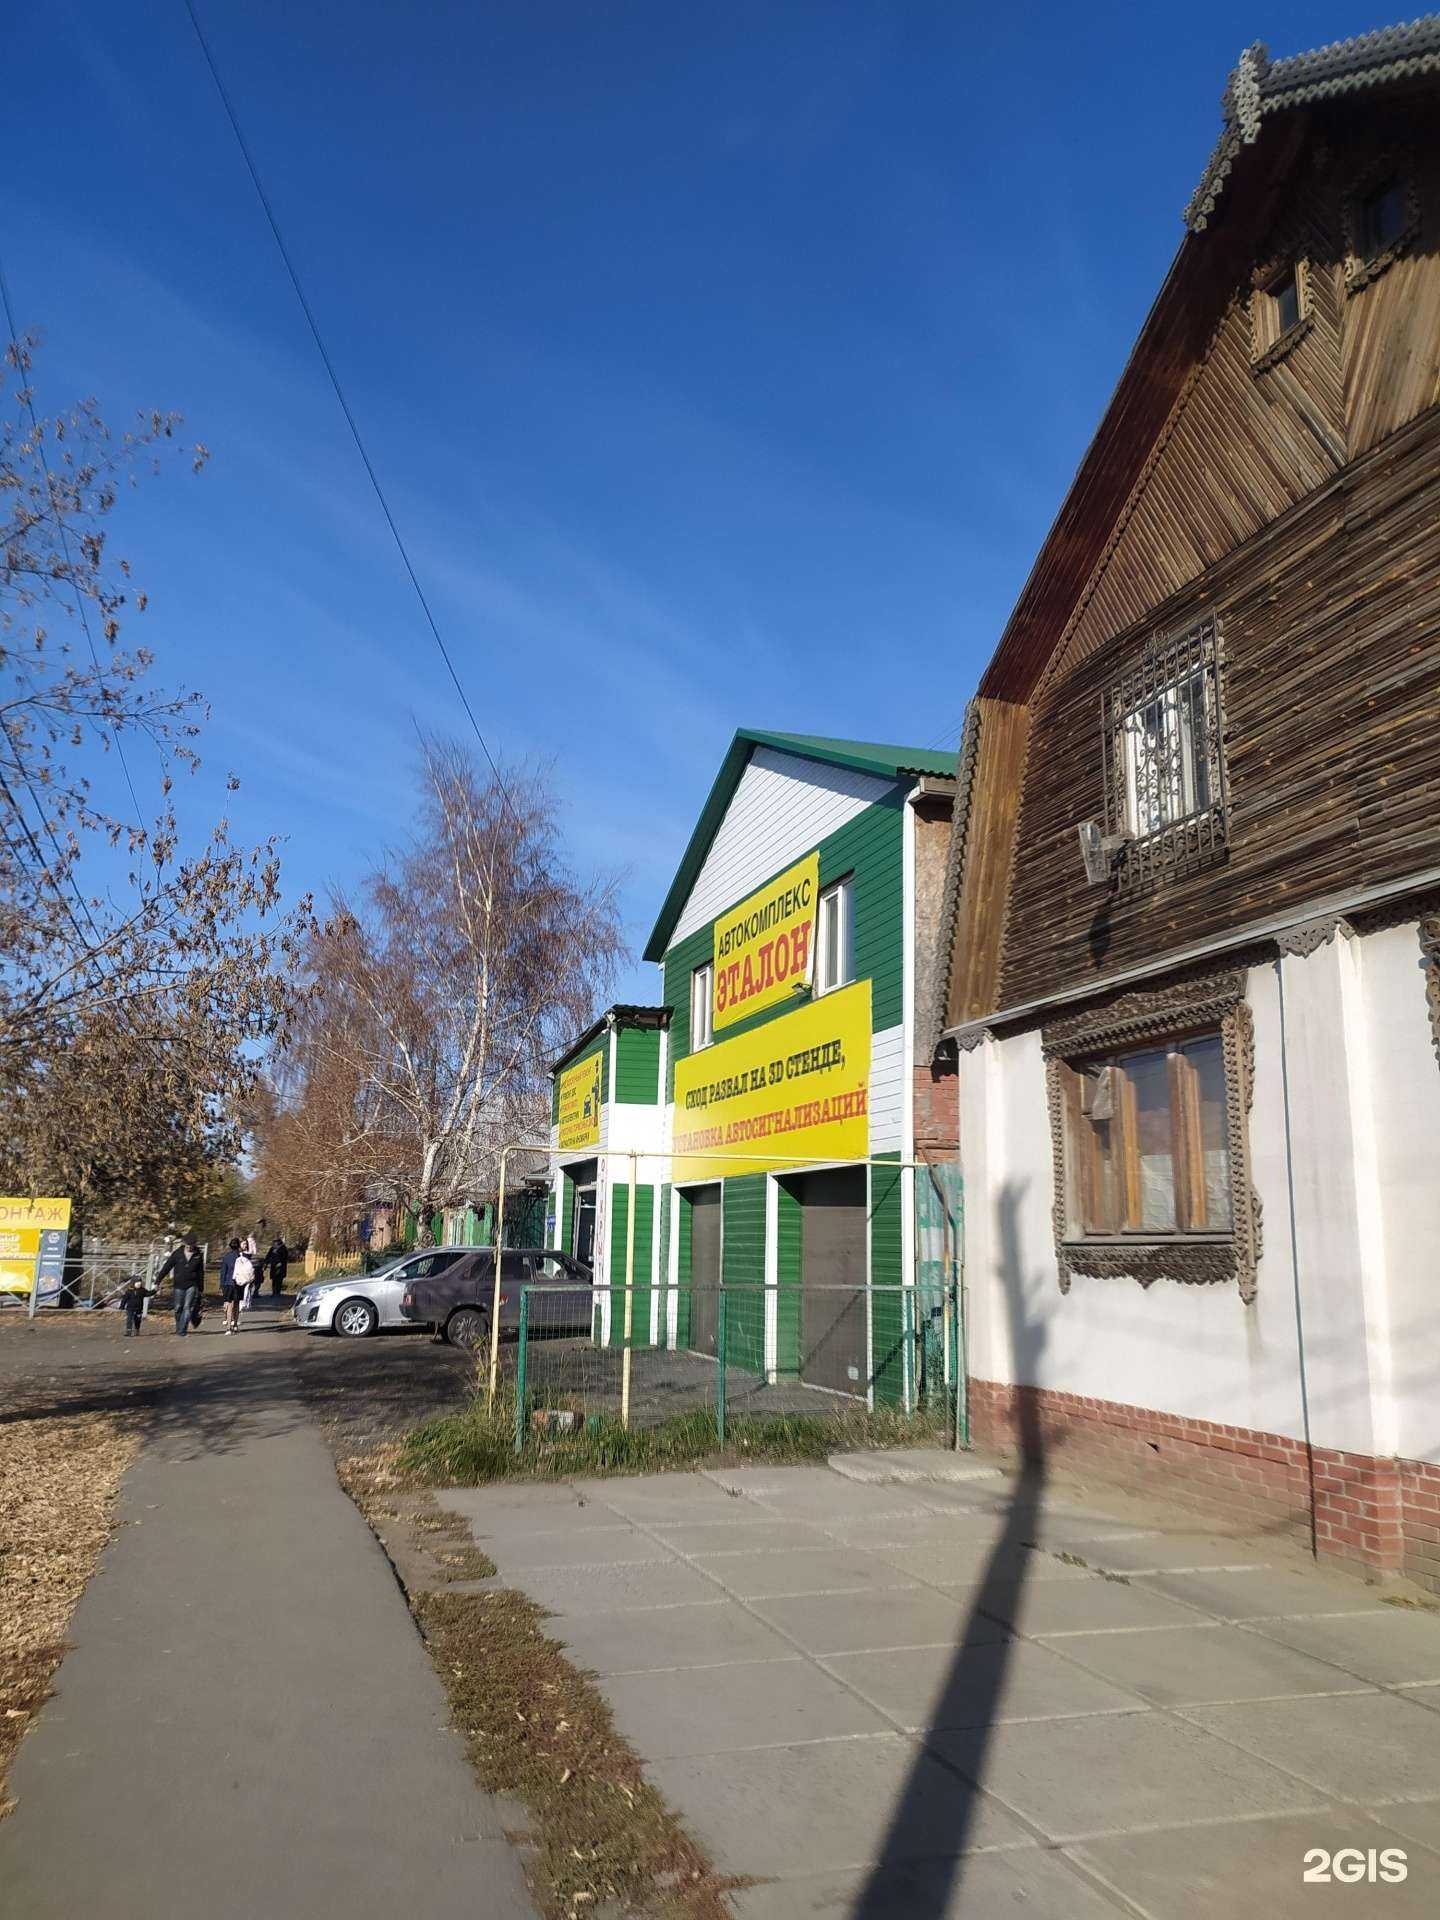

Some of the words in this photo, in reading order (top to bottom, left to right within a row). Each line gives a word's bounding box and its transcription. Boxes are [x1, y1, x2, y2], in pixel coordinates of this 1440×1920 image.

[718, 878, 811, 959] АВТОКОМПЛЕКС
[716, 919, 812, 1012] ЭТАЛОН
[686, 1086, 709, 1110] СХОД
[710, 1070, 749, 1102] РАЗВАЛ
[749, 1066, 767, 1092] НА
[768, 1058, 785, 1086] 3D
[786, 1039, 846, 1081] СТЕНДЕ,
[725, 1082, 868, 1145] АВТОСИГНАЛИЗАЦИЙ
